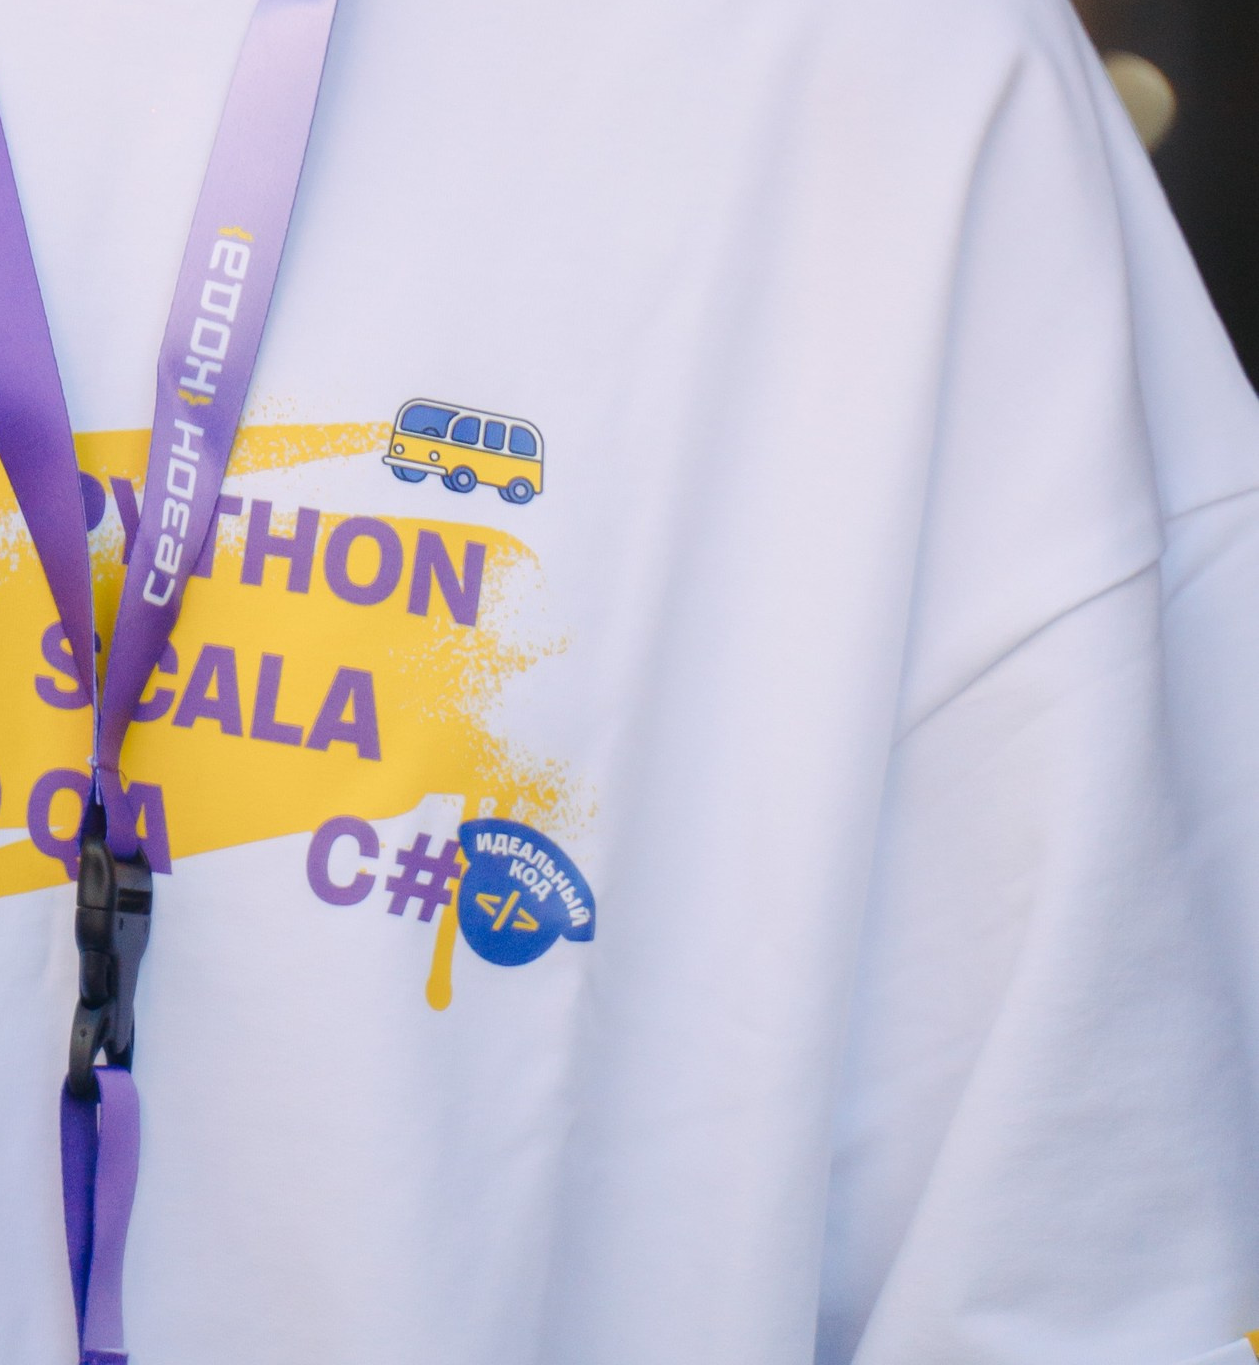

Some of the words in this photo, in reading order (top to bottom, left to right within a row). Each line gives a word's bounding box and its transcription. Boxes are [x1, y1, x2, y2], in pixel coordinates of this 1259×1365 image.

[27, 767, 173, 881] QA
[305, 814, 462, 923] C#
[475, 832, 591, 928] ИДЕАЛЬНЫЙ
[508, 859, 553, 903] КОД
